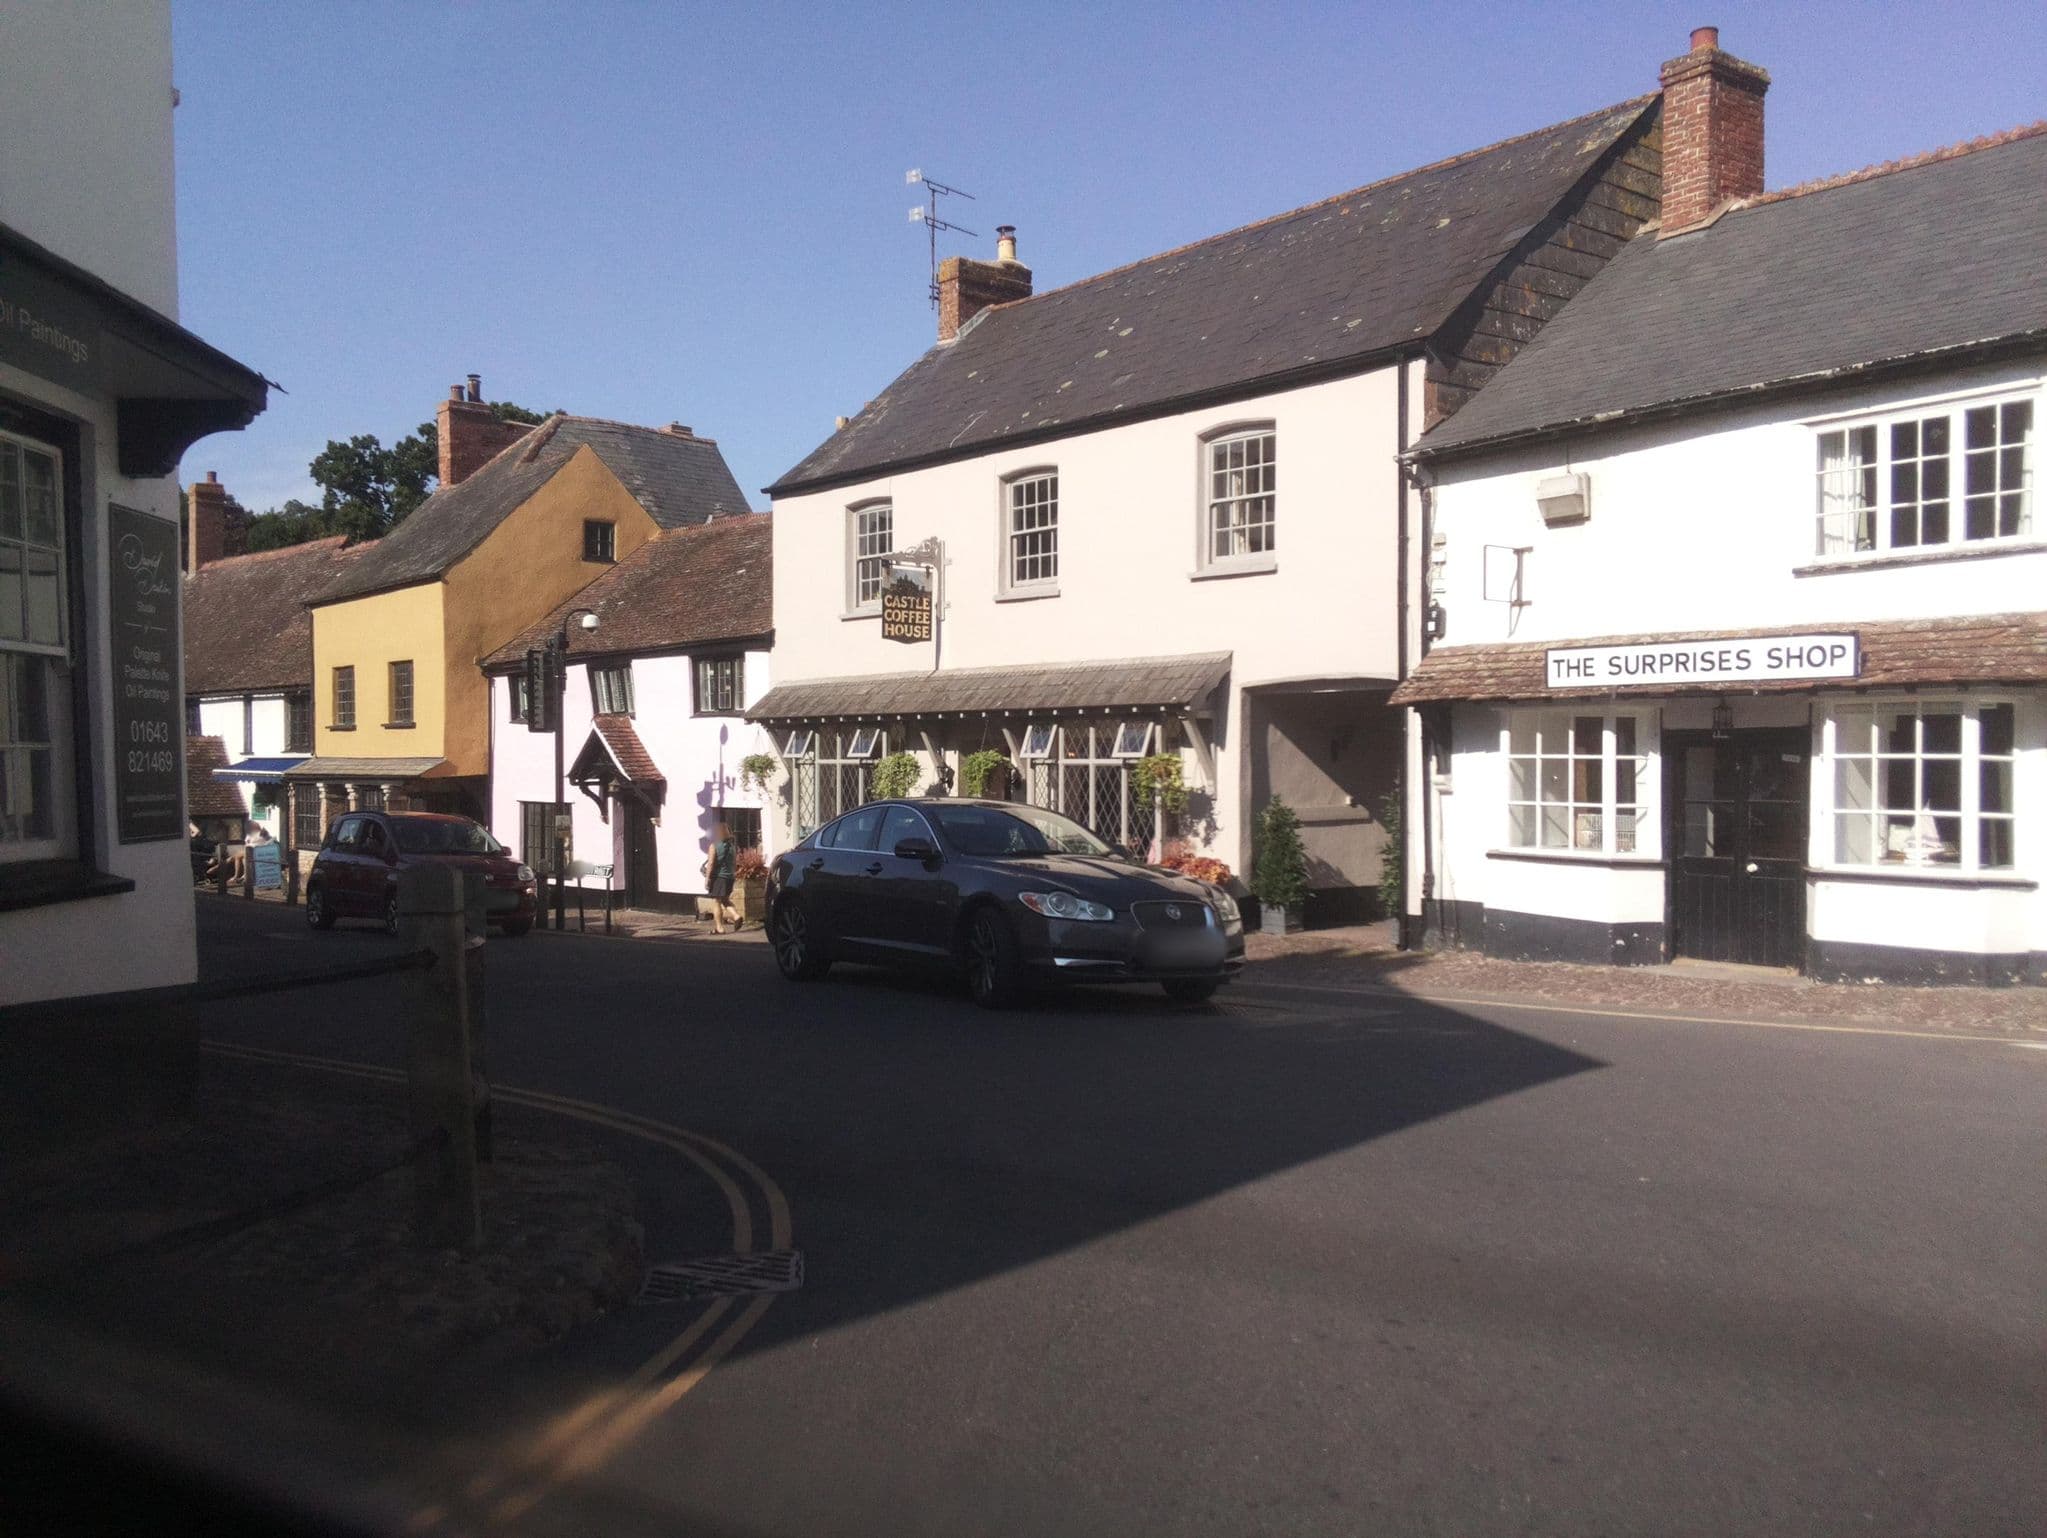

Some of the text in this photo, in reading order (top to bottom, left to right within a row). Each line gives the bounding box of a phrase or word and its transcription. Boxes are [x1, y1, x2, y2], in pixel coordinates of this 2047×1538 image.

[19, 307, 88, 363] Paintings
[885, 594, 930, 609] CASTLE
[885, 609, 930, 624] COFFEE
[885, 623, 930, 638] HOUSE
[1553, 644, 1847, 679] THE SURPRISES SHOP
[138, 685, 170, 703] Paintings
[131, 720, 169, 743] 01643
[128, 750, 173, 773] 821469
